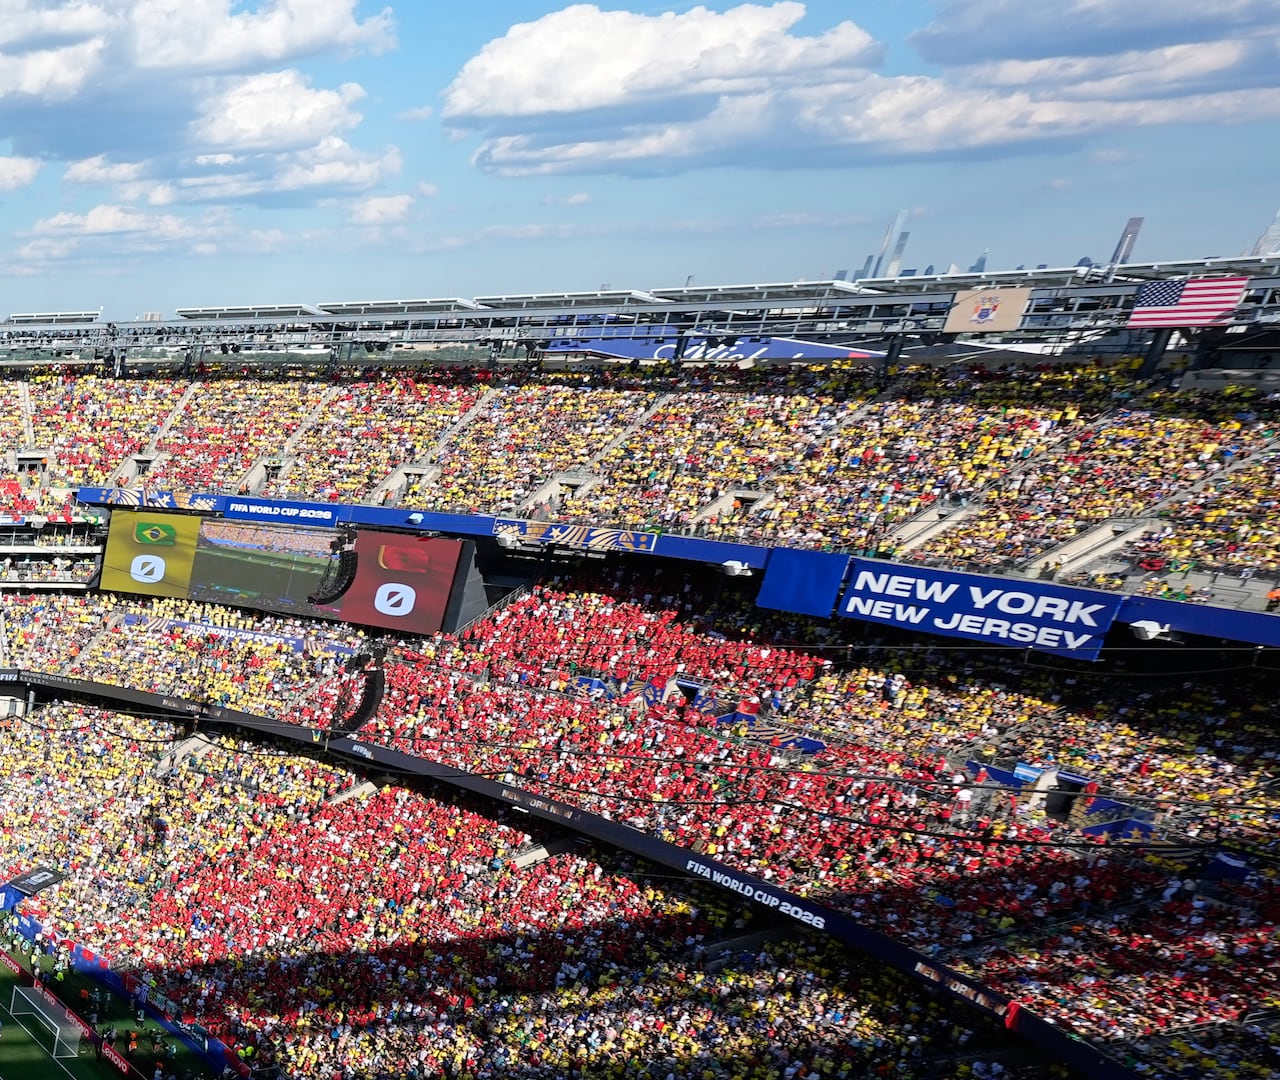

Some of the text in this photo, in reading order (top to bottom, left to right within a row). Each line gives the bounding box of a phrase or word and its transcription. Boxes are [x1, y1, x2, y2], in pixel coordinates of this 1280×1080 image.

[229, 503, 333, 520] FIFA WORLD CUP 2026
[130, 555, 166, 584] 0
[374, 583, 417, 617] 0
[854, 570, 1106, 627] NEW YORK
[846, 597, 1093, 650] NEW JERSEY
[0, 673, 17, 681] FIFA
[686, 859, 826, 930] FIFA WORLD CUP 2026
[0, 950, 21, 974] Lenovo
[33, 979, 56, 1006] Leovo
[66, 1008, 90, 1037] Lenovo
[103, 1043, 128, 1073] Lenovo
